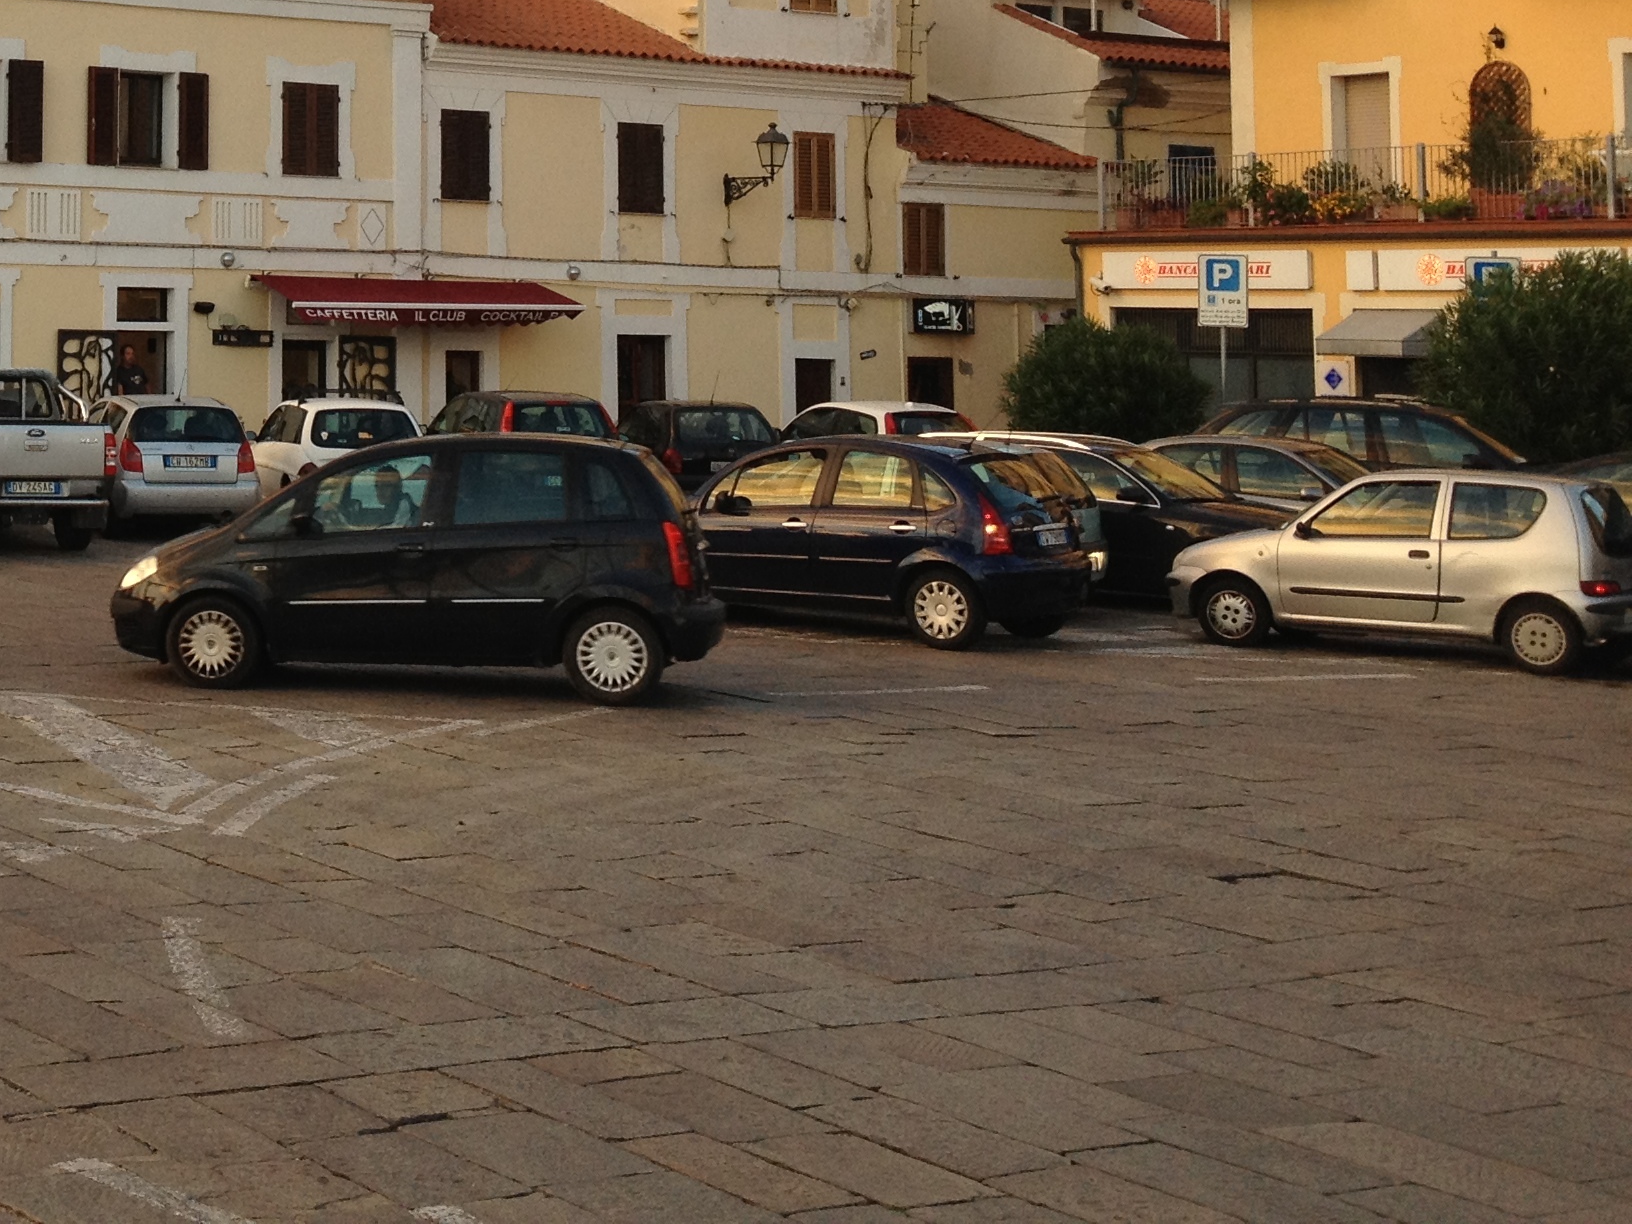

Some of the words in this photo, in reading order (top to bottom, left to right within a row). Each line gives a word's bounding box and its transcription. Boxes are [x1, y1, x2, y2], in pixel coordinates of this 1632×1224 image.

[1157, 265, 1198, 275] BANCA
[1212, 262, 1234, 288] P
[1227, 297, 1242, 305] ora
[305, 308, 399, 322] CAFFETTERIA
[414, 310, 427, 322] IL
[429, 311, 467, 322] CLUB
[480, 311, 544, 322] COCKTAIL
